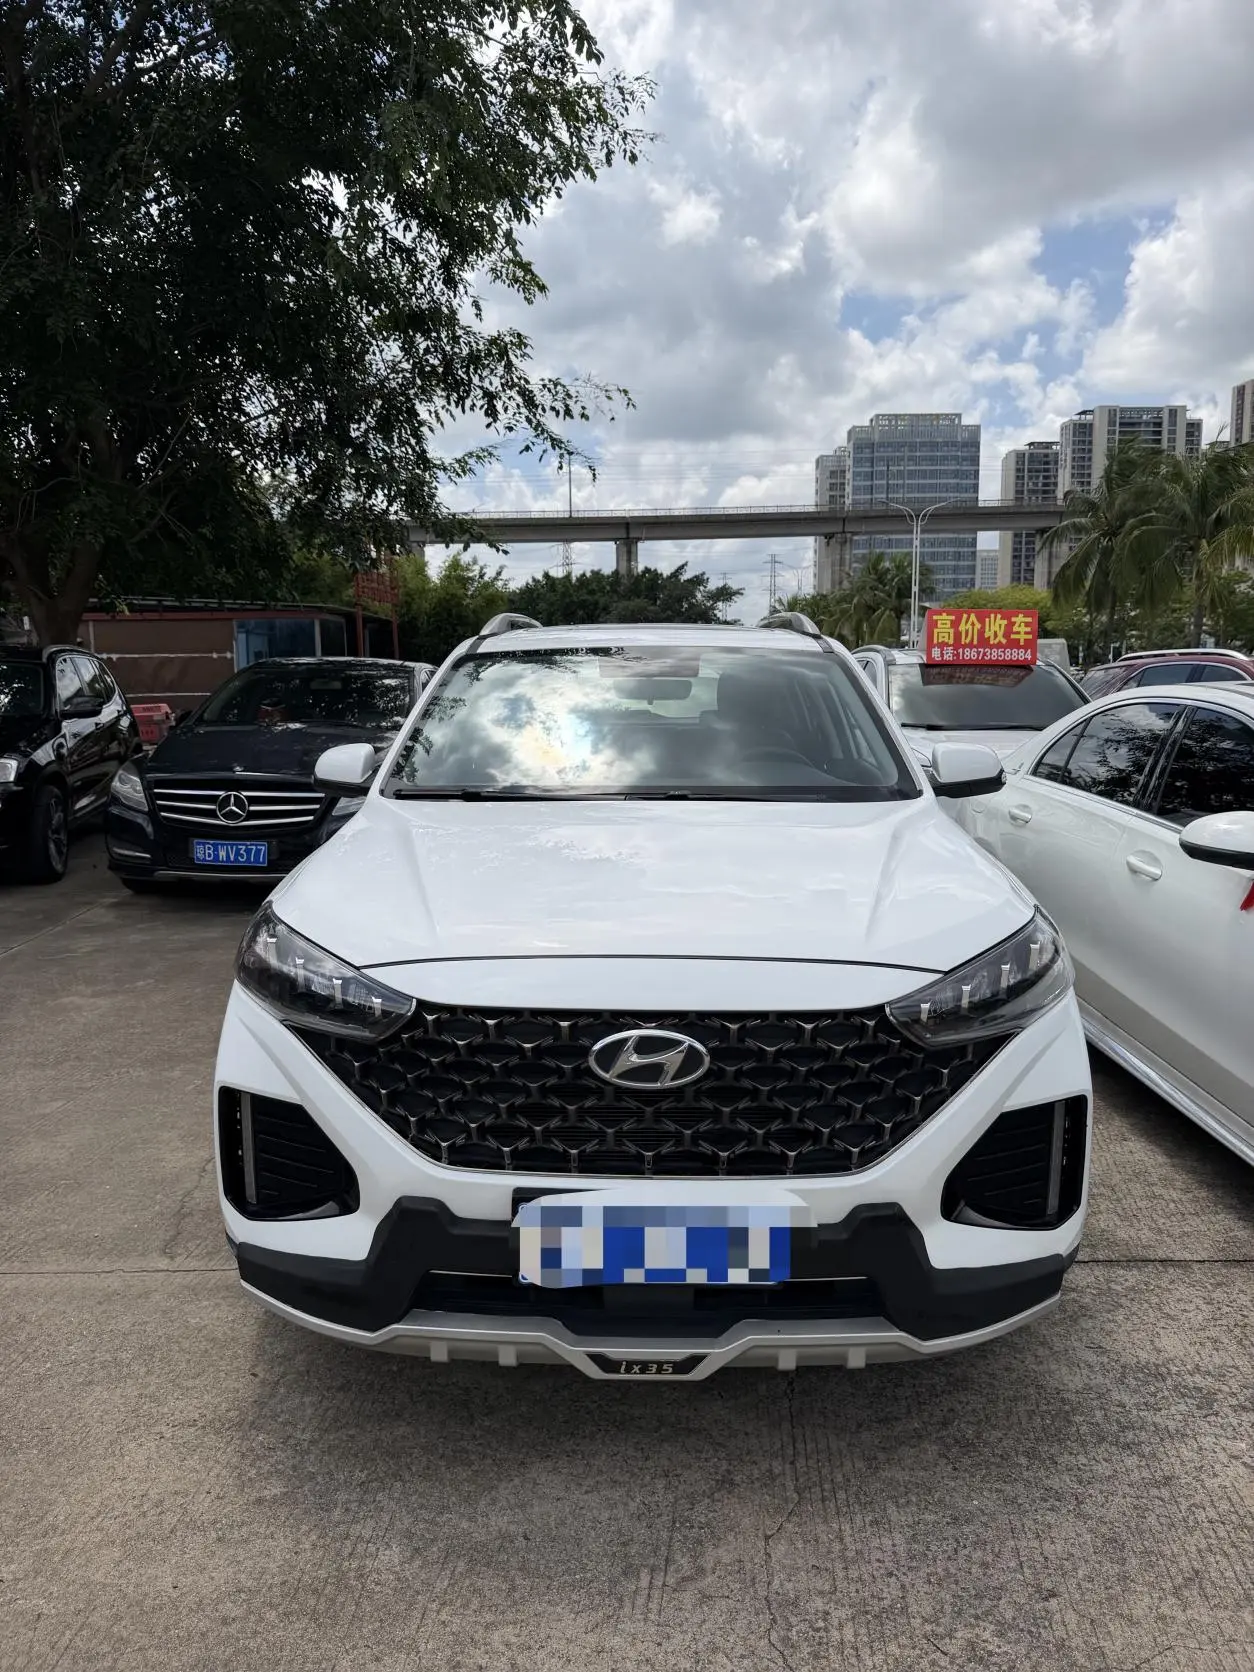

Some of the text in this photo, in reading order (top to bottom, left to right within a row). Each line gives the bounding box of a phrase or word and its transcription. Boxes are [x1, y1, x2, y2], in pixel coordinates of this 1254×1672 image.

[932, 612, 1033, 645] 高价收车
[620, 1361, 674, 1374] ix35
